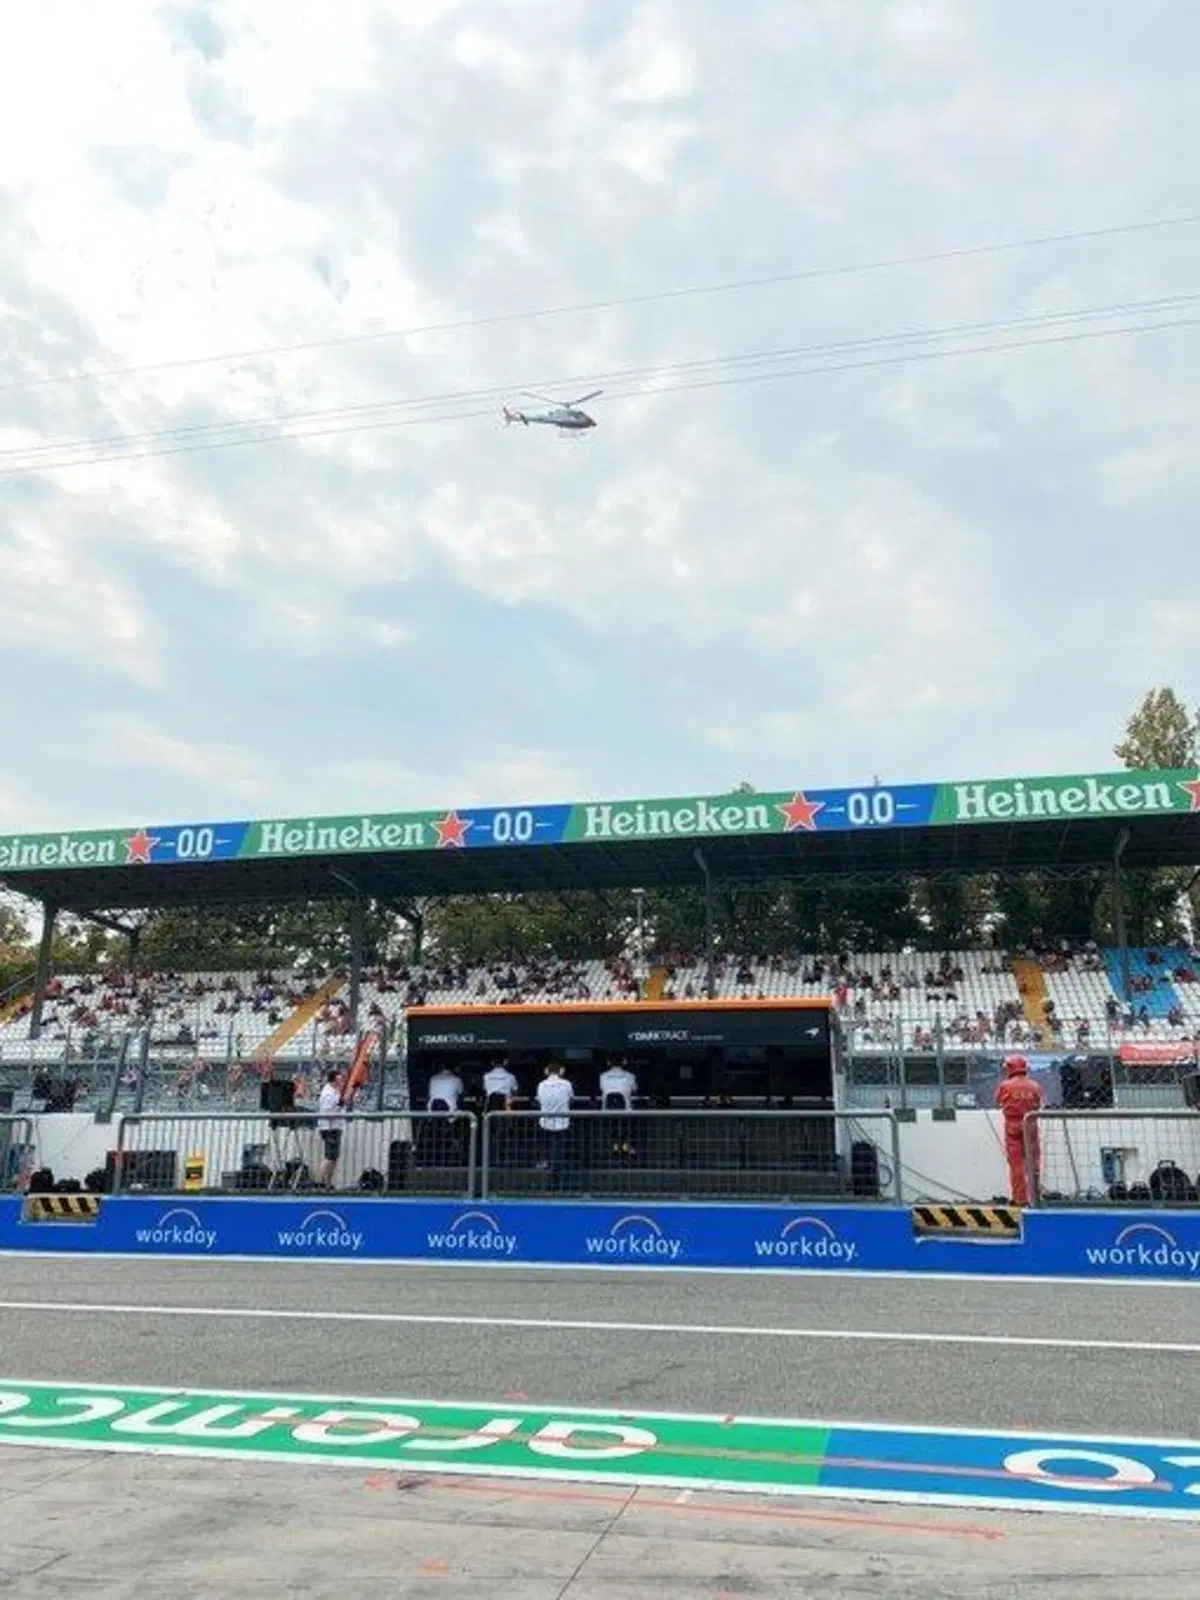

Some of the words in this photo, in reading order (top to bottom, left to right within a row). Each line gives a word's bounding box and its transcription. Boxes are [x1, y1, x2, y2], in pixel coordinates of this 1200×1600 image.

[954, 779, 1174, 820] Heineken
[583, 801, 769, 838] Heineken
[847, 791, 893, 825] 0.0
[176, 828, 213, 858] 0.0
[258, 818, 425, 854] Heineken
[493, 811, 533, 843] 0.0
[136, 1225, 216, 1248] workday
[277, 1227, 362, 1251] workday
[427, 1228, 516, 1255] workday
[586, 1233, 681, 1259] workday
[754, 1236, 856, 1262] workday
[1086, 1243, 1200, 1272] workday
